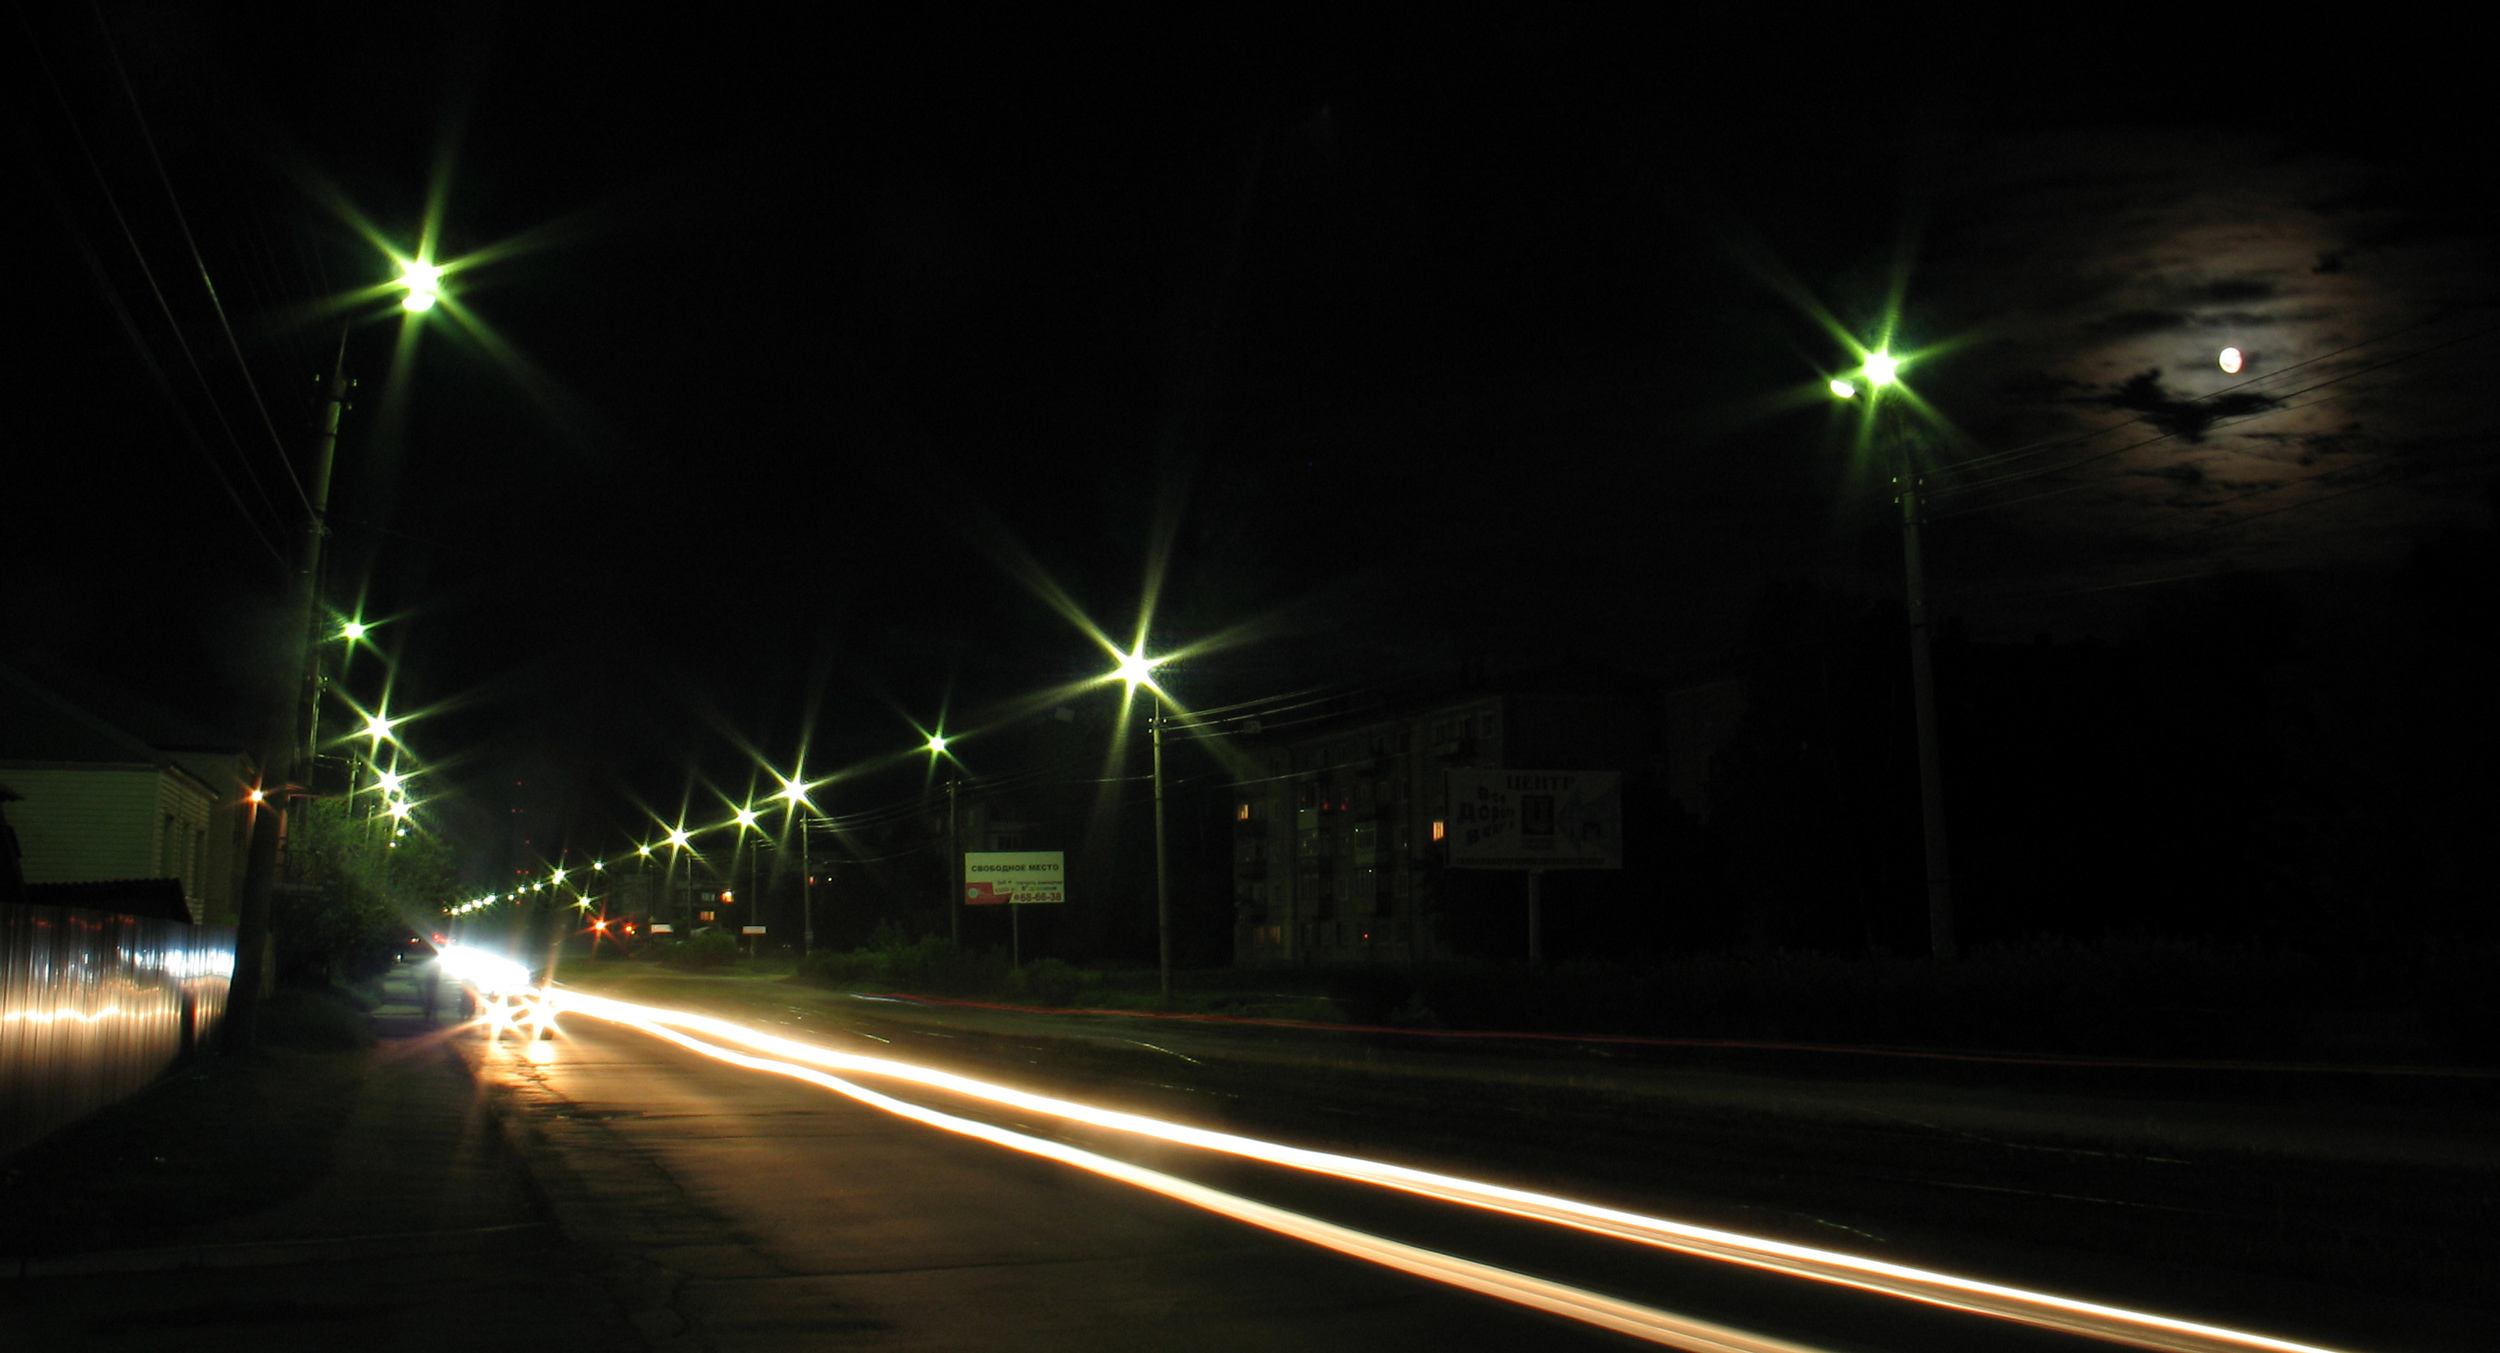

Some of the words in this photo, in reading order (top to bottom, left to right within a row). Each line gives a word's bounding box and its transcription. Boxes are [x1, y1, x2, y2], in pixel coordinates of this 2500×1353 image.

[1506, 775, 1576, 791] ЦЕНТР
[971, 864, 1026, 872] СВОБОДНОЕ
[1029, 863, 1059, 871] МЕСТО
